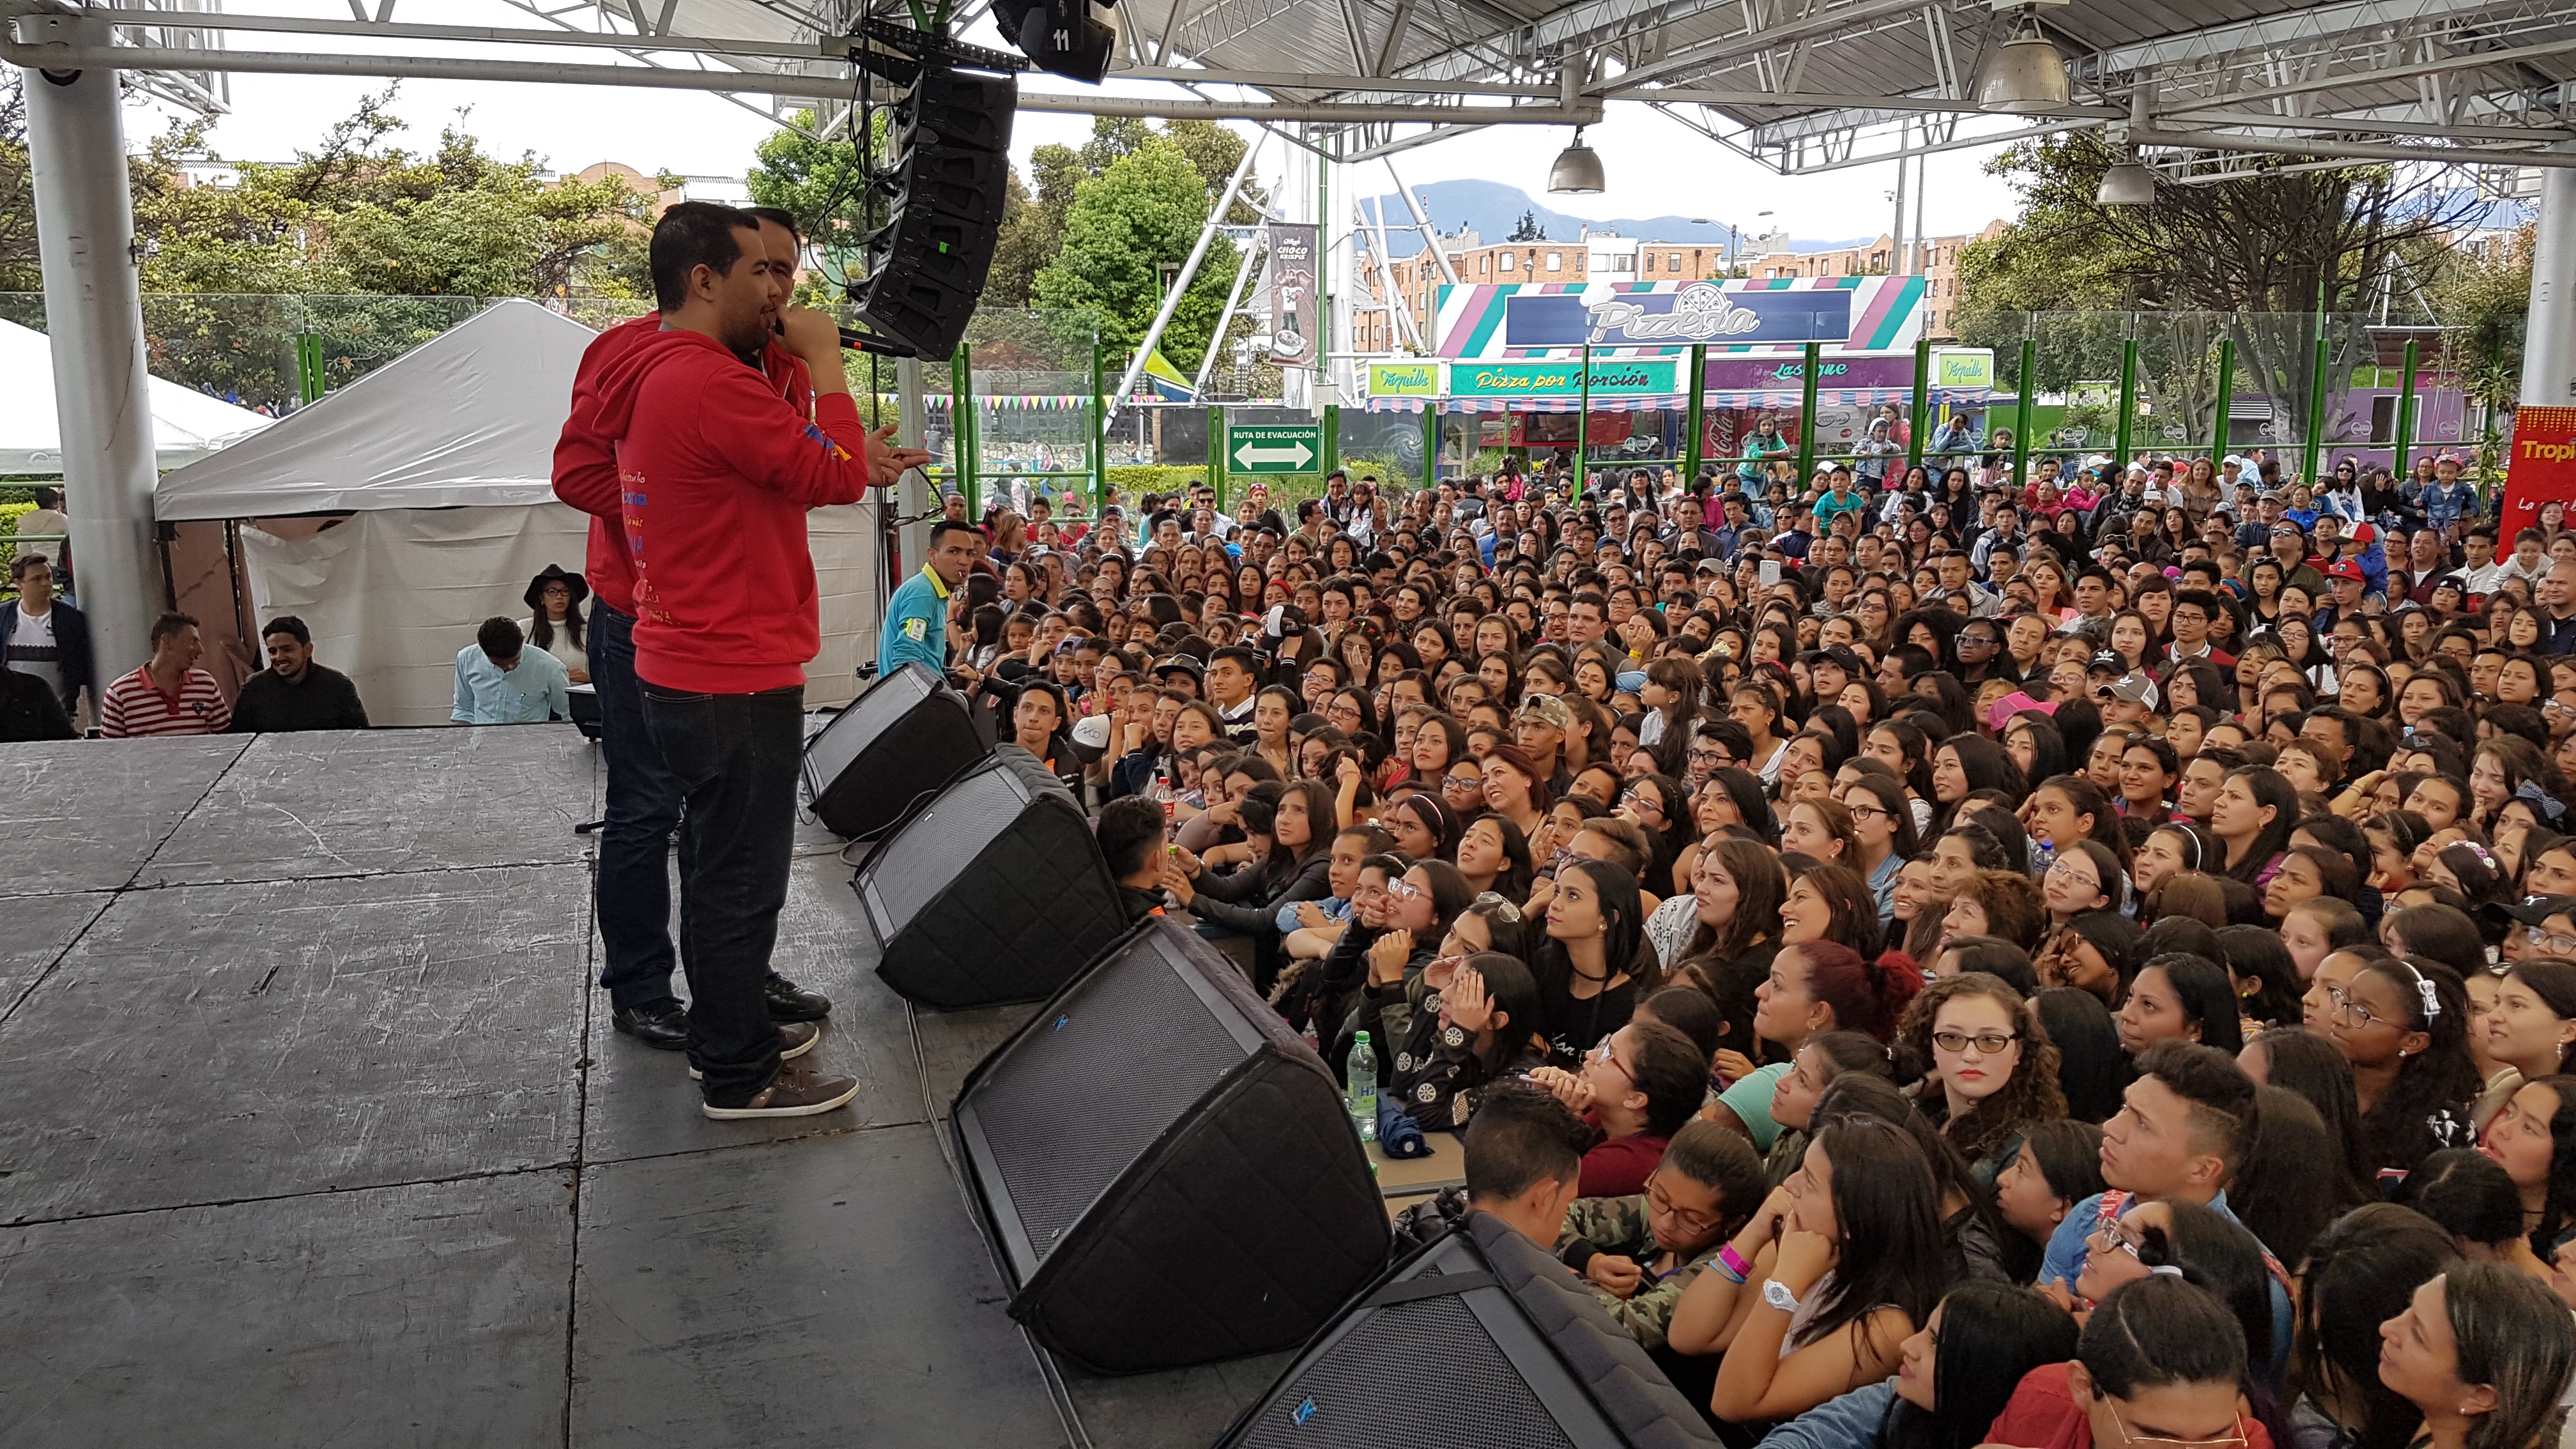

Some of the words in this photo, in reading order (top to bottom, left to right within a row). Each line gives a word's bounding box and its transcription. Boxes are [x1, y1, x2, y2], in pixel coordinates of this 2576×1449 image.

[1054, 29, 1070, 50] 11
[1276, 246, 1308, 255] CHOCO
[1475, 367, 1530, 389] Pizza
[1529, 374, 1566, 392] por
[1268, 430, 1316, 439] EVACUACIÓN
